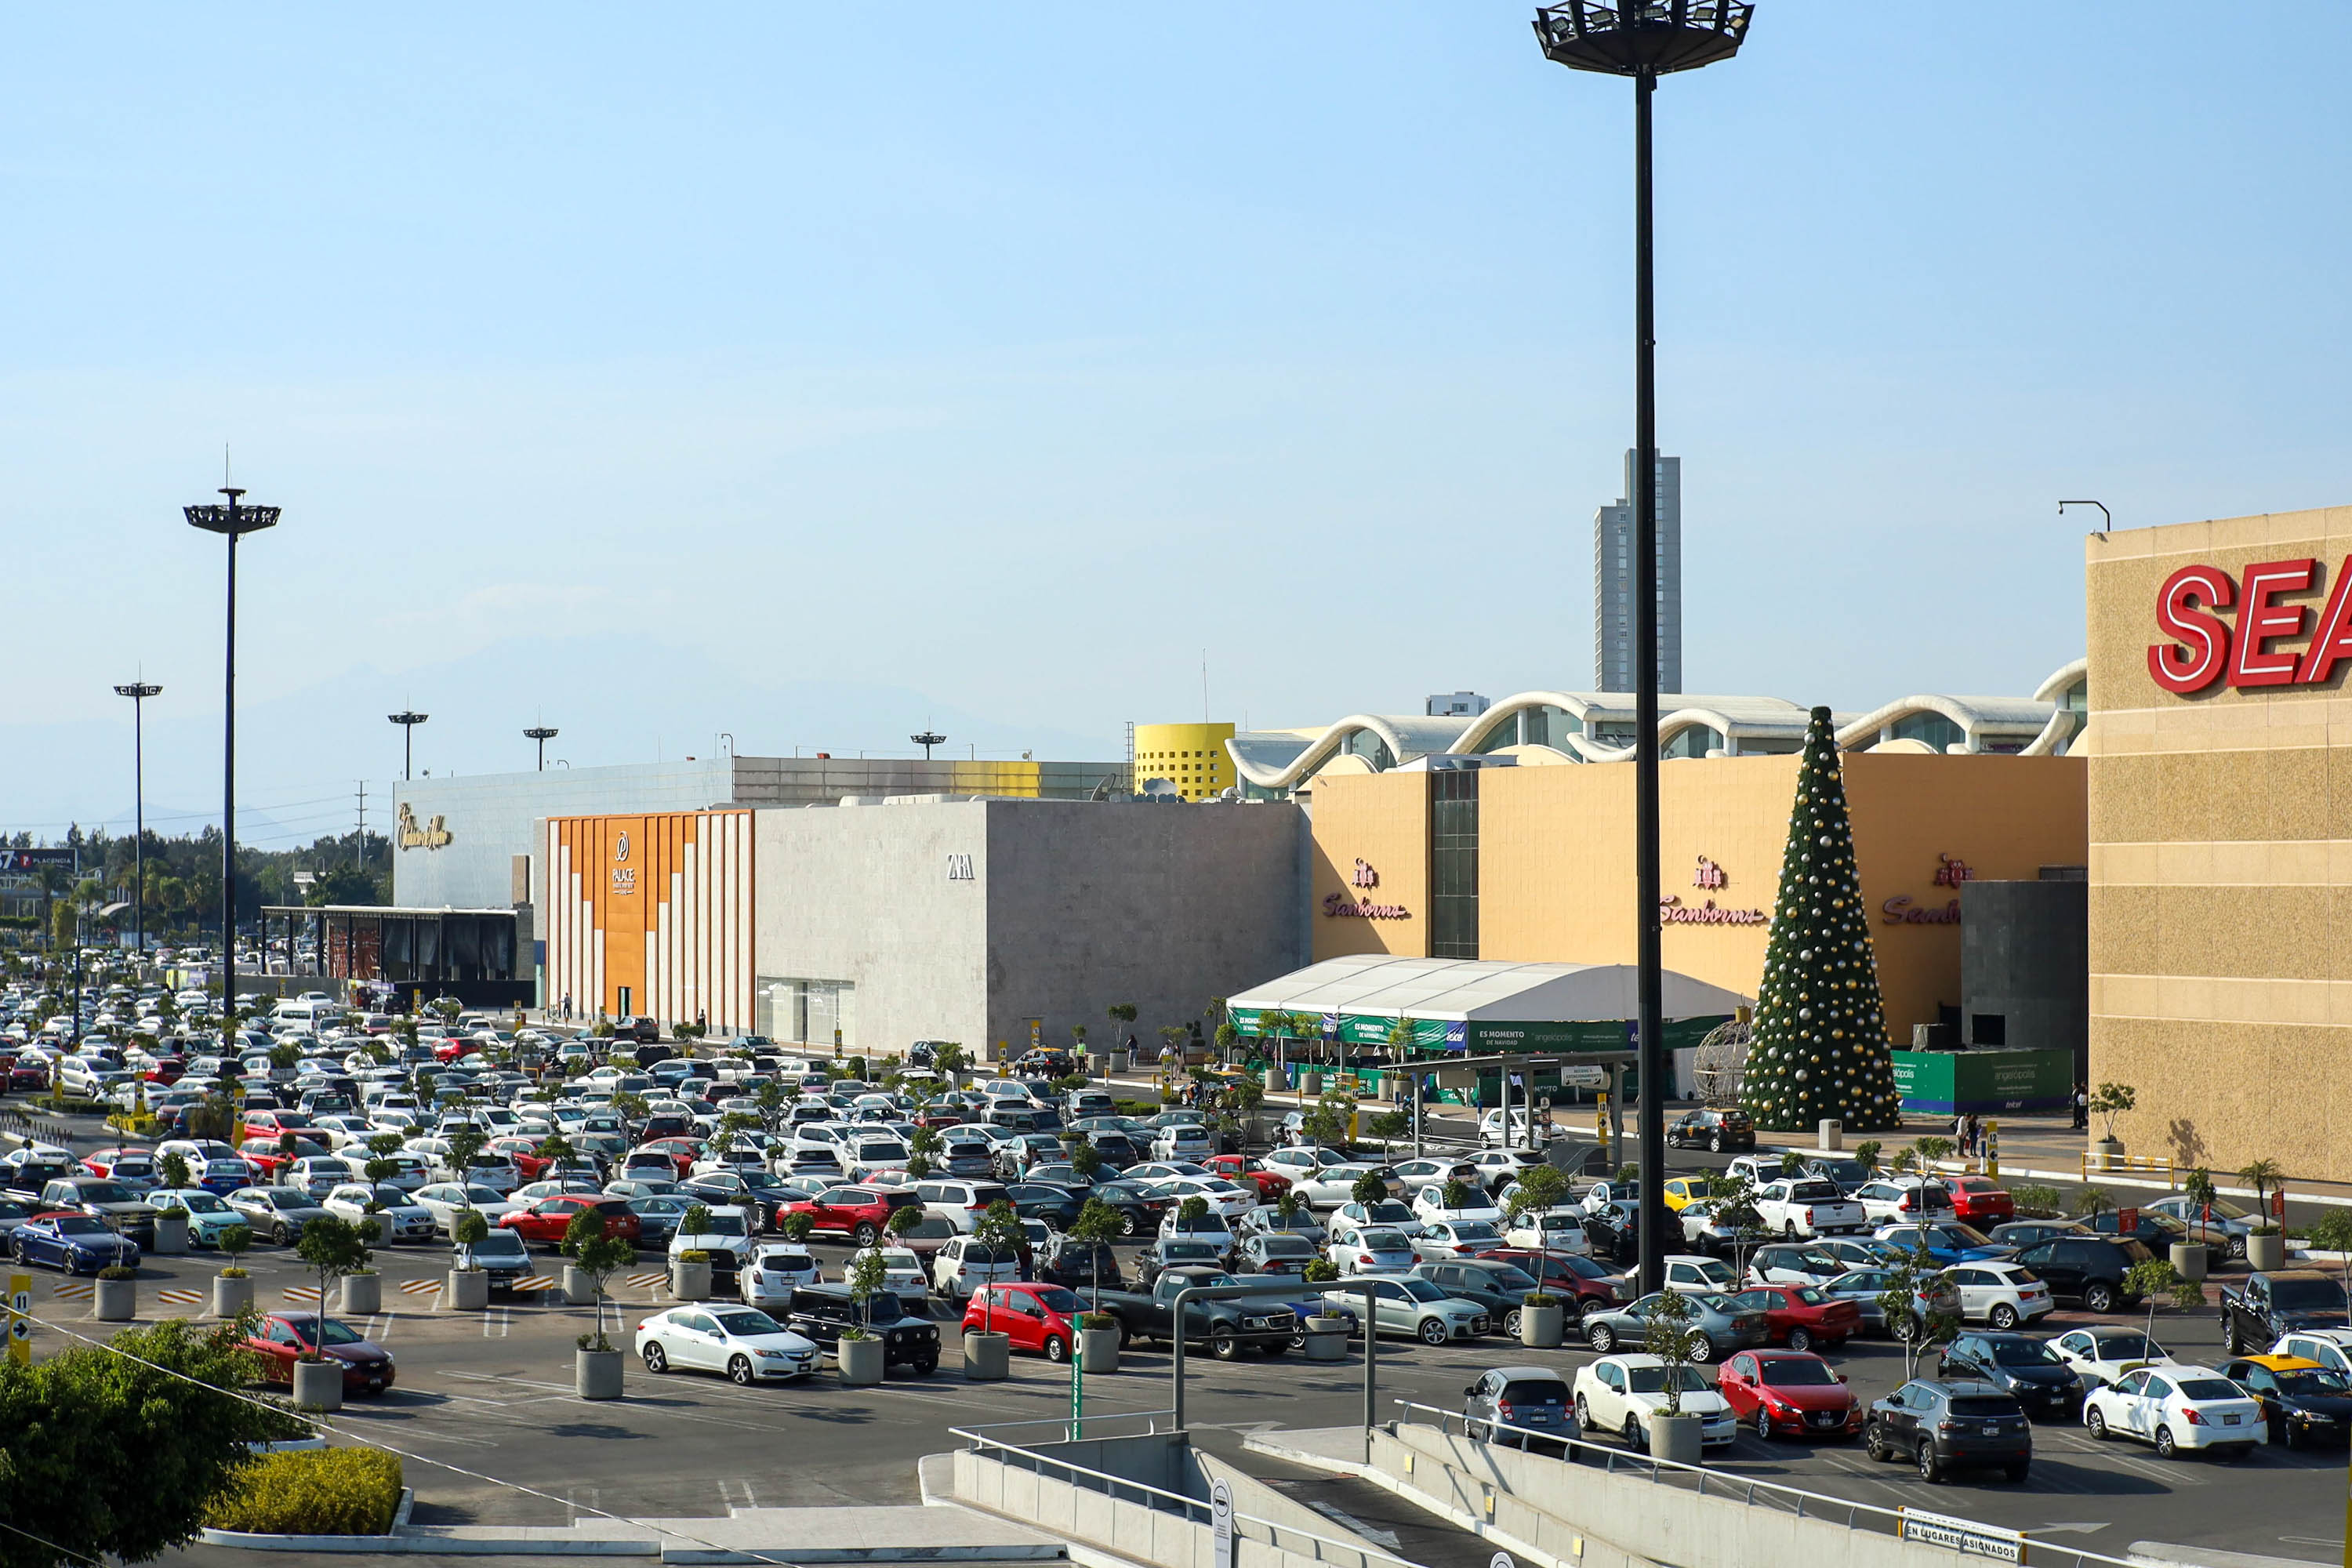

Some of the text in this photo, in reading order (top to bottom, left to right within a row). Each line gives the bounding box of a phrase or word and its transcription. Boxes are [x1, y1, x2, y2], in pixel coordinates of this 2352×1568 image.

[947, 853, 975, 880] ZARA
[612, 868, 634, 882] PALACE
[1323, 894, 1406, 917] Sanborns
[1882, 896, 1961, 924] Sanb
[1360, 1023, 1384, 1033] MOMENTO
[1893, 1068, 1915, 1079] elópolis
[1989, 1133, 1997, 1142] 12
[17, 1295, 27, 1309] 11
[1907, 1526, 1918, 1536] EN
[1921, 1528, 1960, 1544] LUGARES
[1963, 1539, 2016, 1558] ASIGNADOS
